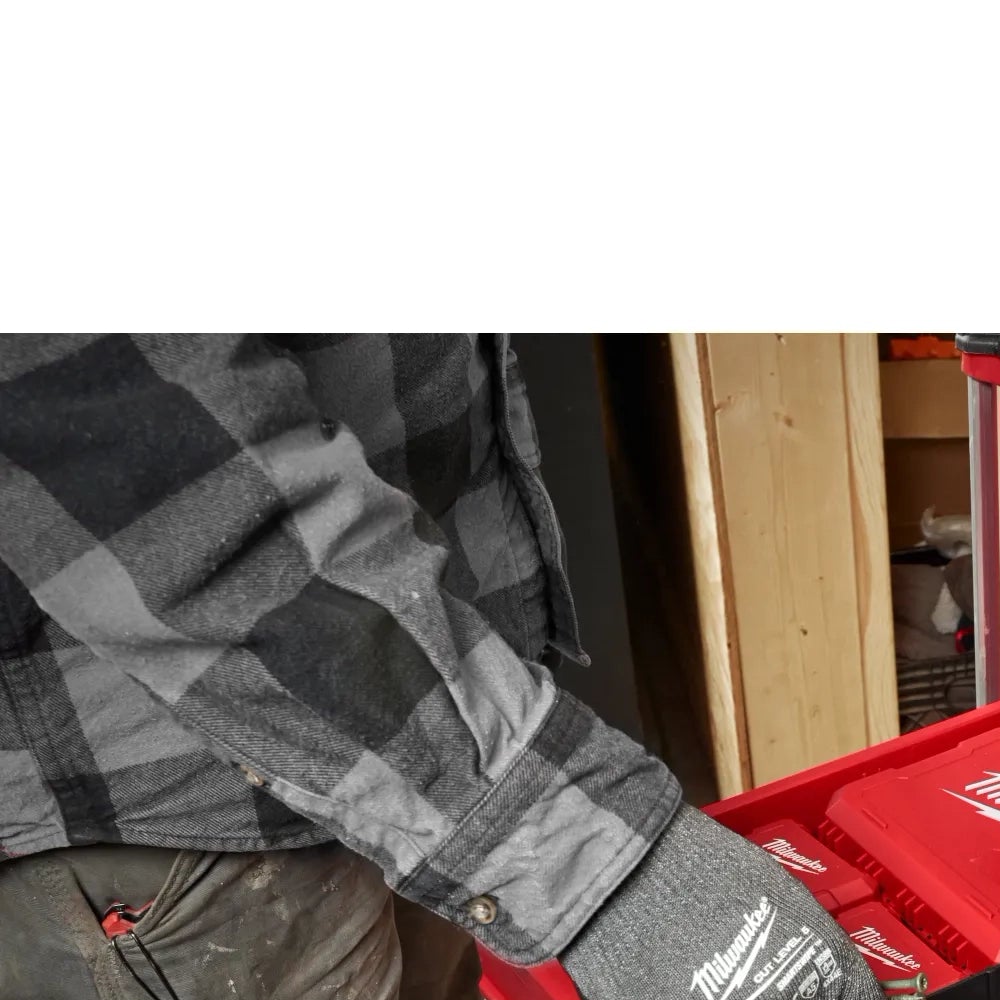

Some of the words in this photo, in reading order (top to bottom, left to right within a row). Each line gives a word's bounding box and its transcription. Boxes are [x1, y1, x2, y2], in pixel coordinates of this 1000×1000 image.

[762, 838, 828, 873] Milwaukee
[690, 899, 770, 1000] Milwaukee
[753, 964, 775, 984] CUT
[773, 936, 803, 965] LEVEL
[850, 926, 921, 970] Milwaukee
